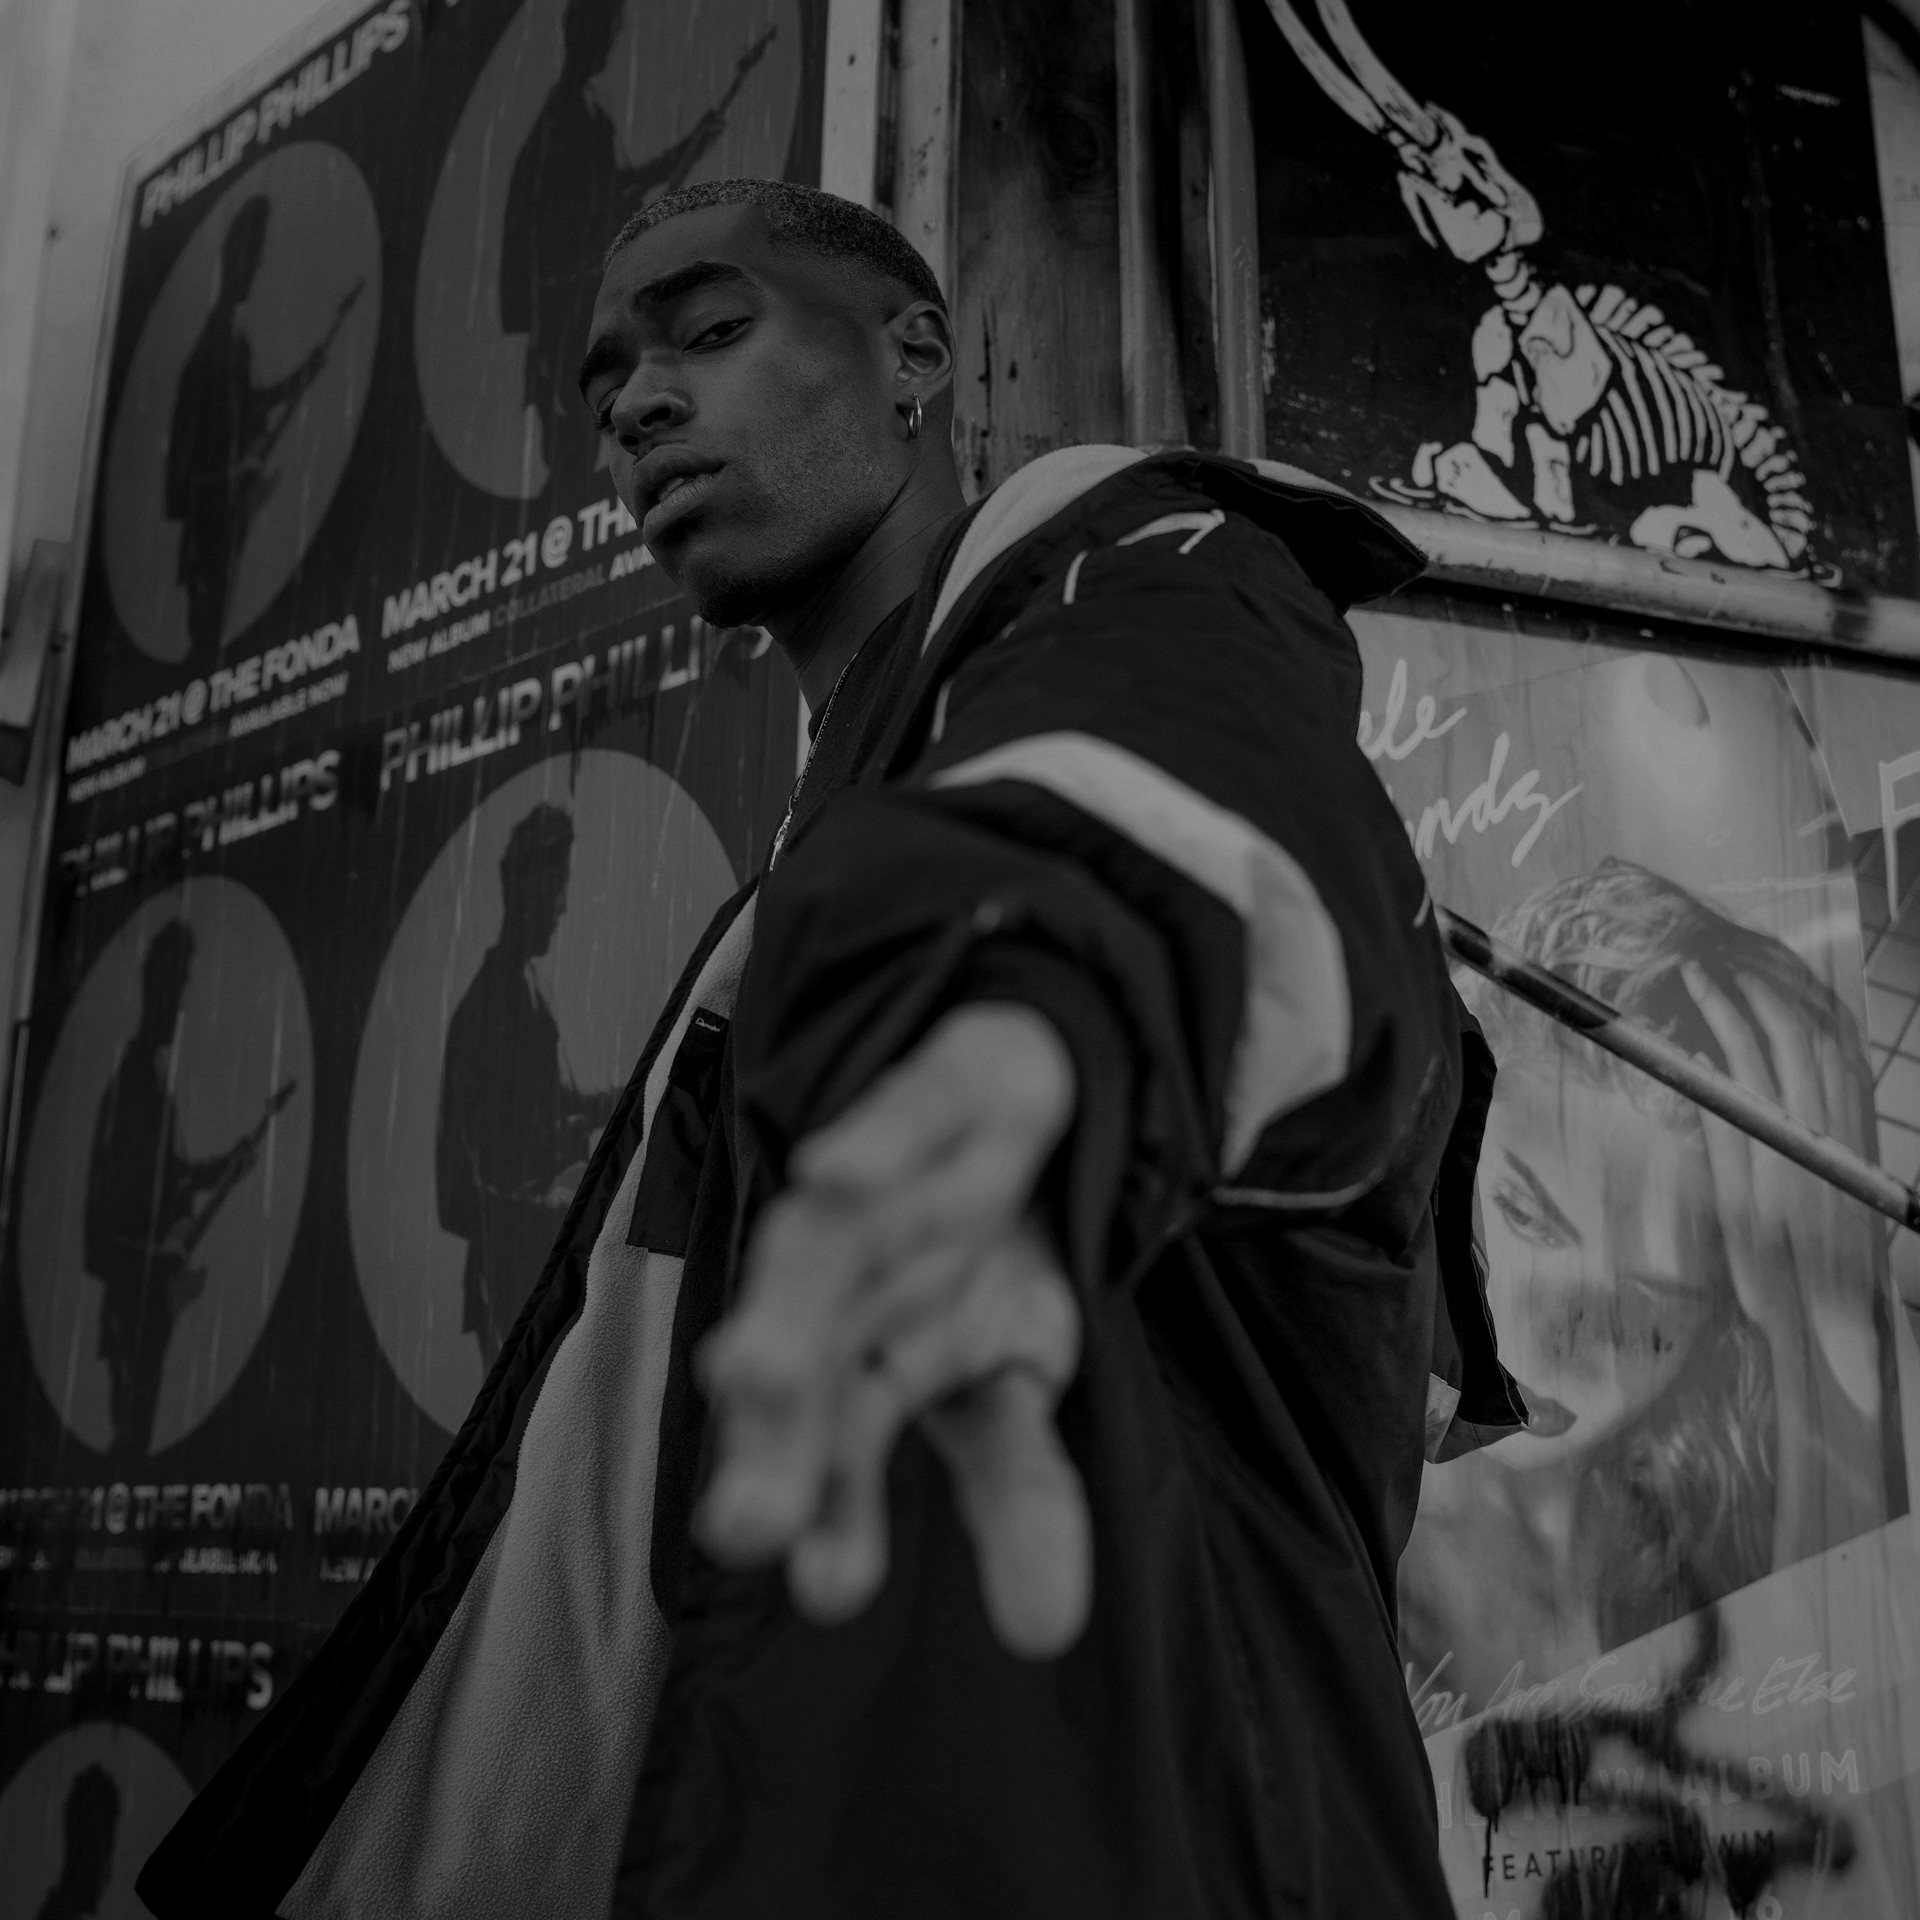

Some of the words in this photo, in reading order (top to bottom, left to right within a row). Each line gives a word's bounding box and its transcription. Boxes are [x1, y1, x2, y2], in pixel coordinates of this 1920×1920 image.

[138, 107, 258, 230] PHILLIP
[255, 0, 410, 145] PHILLIPS
[380, 547, 499, 640] MARCH
[499, 530, 538, 588] 21
[540, 514, 573, 568] @
[65, 701, 153, 775] MARCH
[153, 689, 183, 738] 21
[208, 655, 261, 713] THE
[261, 612, 361, 692] FONDA
[387, 635, 429, 674] NEW
[427, 608, 491, 658] ALBUM
[379, 677, 543, 793] PHILLIP
[1751, 1652, 1857, 1715] Else
[1680, 1748, 1860, 1808] ALBUM
